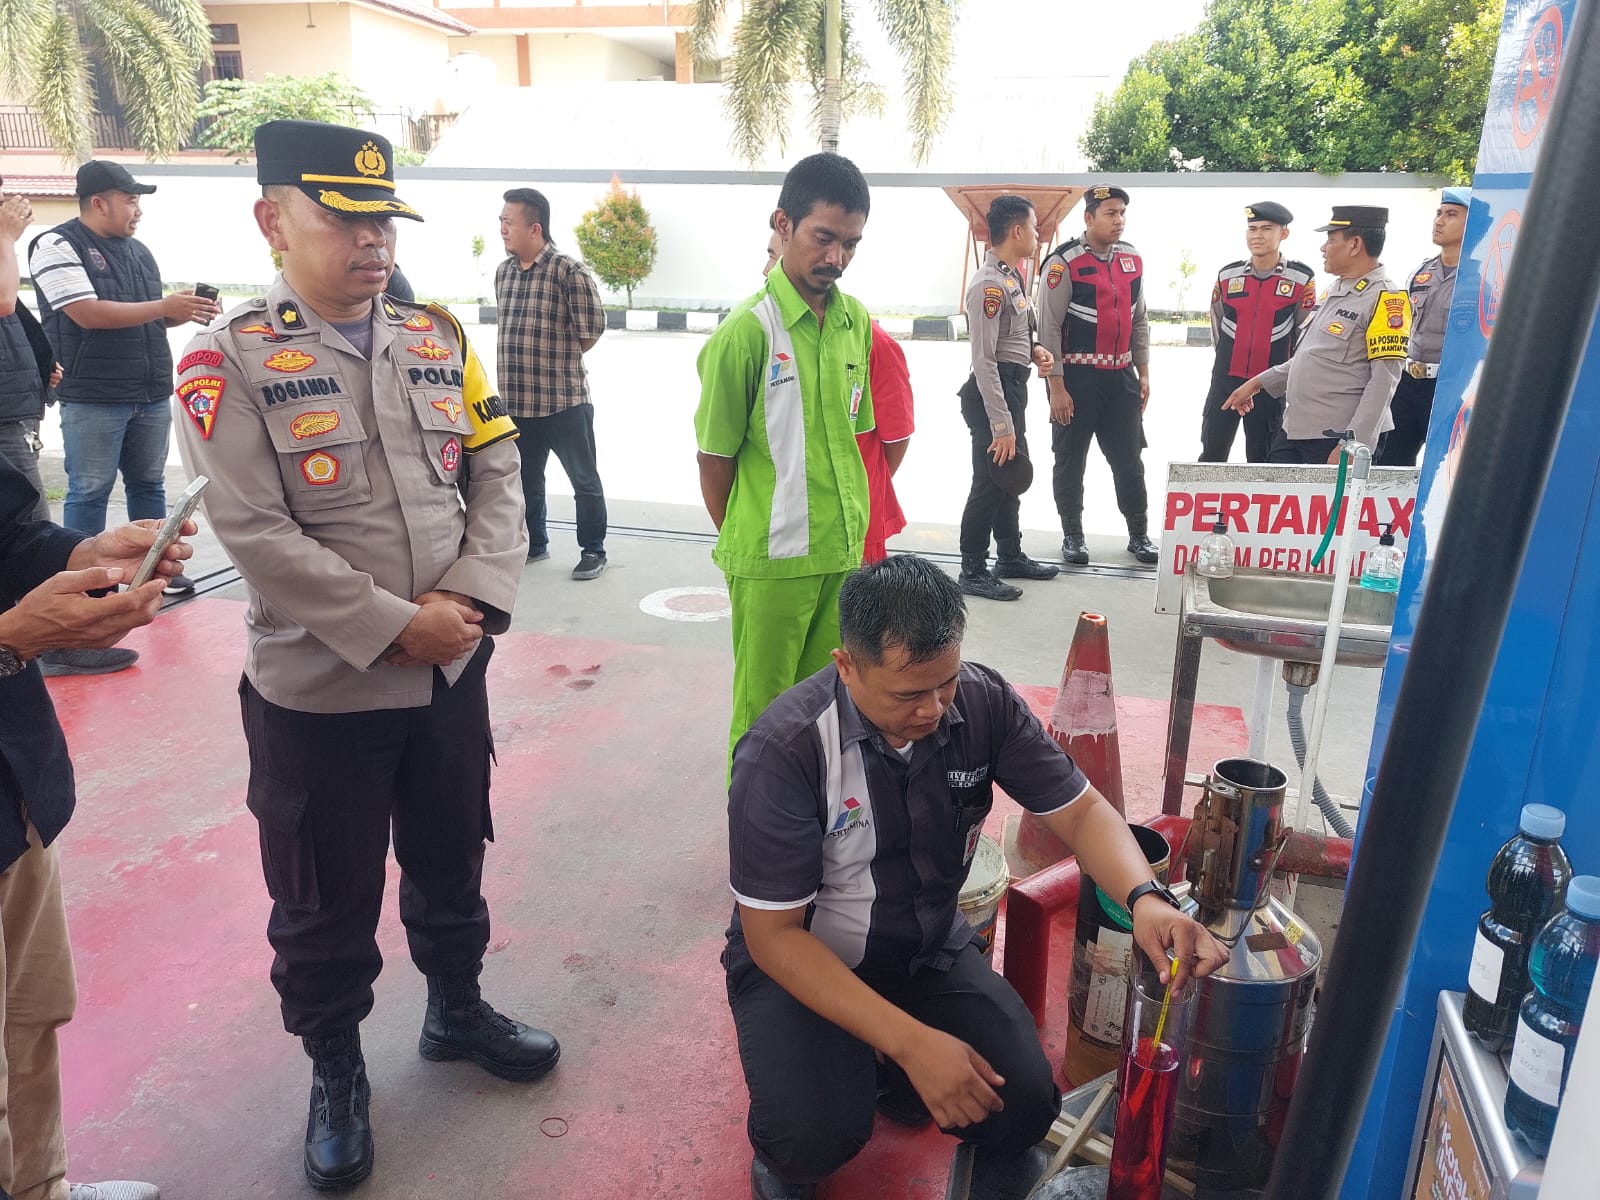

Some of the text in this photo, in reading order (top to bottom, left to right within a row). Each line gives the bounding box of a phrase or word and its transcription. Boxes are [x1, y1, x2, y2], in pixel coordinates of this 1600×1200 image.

[1335, 308, 1358, 321] POLRI
[1378, 335, 1399, 345] POSKO
[180, 378, 222, 395] OPS POLRI
[261, 376, 342, 406] ROGANDA
[1165, 492, 1416, 538] PERTAMAX
